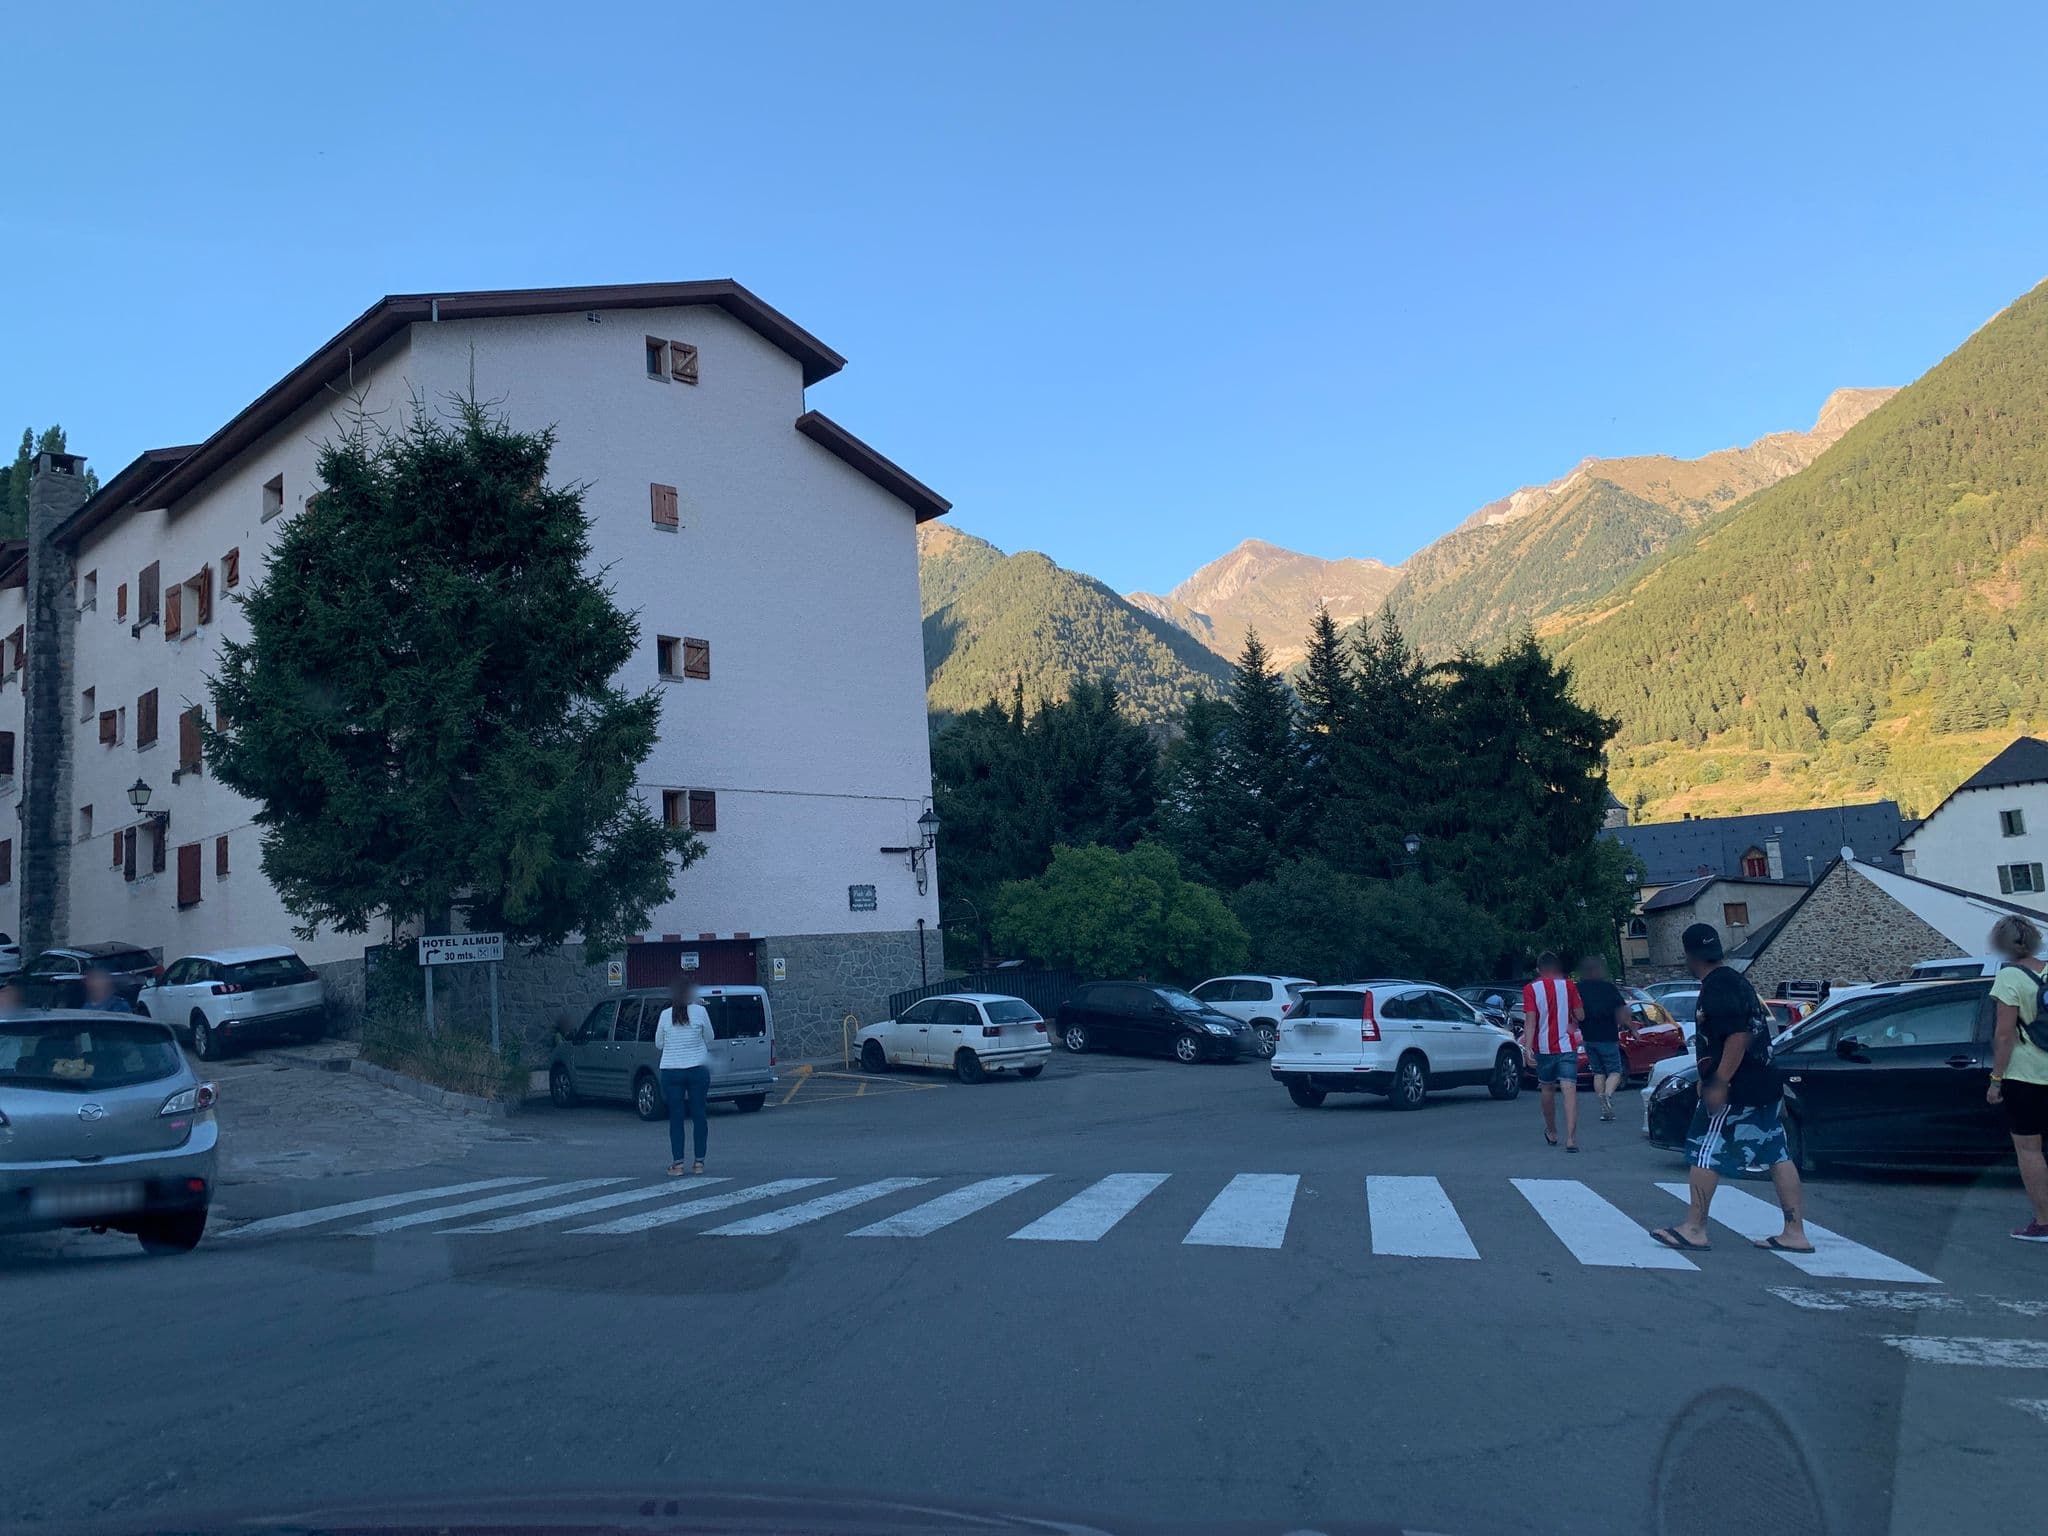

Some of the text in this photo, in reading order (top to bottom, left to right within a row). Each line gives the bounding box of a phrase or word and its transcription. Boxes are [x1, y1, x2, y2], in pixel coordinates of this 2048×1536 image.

[422, 936, 499, 948] HOTEL ALMUD
[444, 951, 476, 961] 30 mts.
